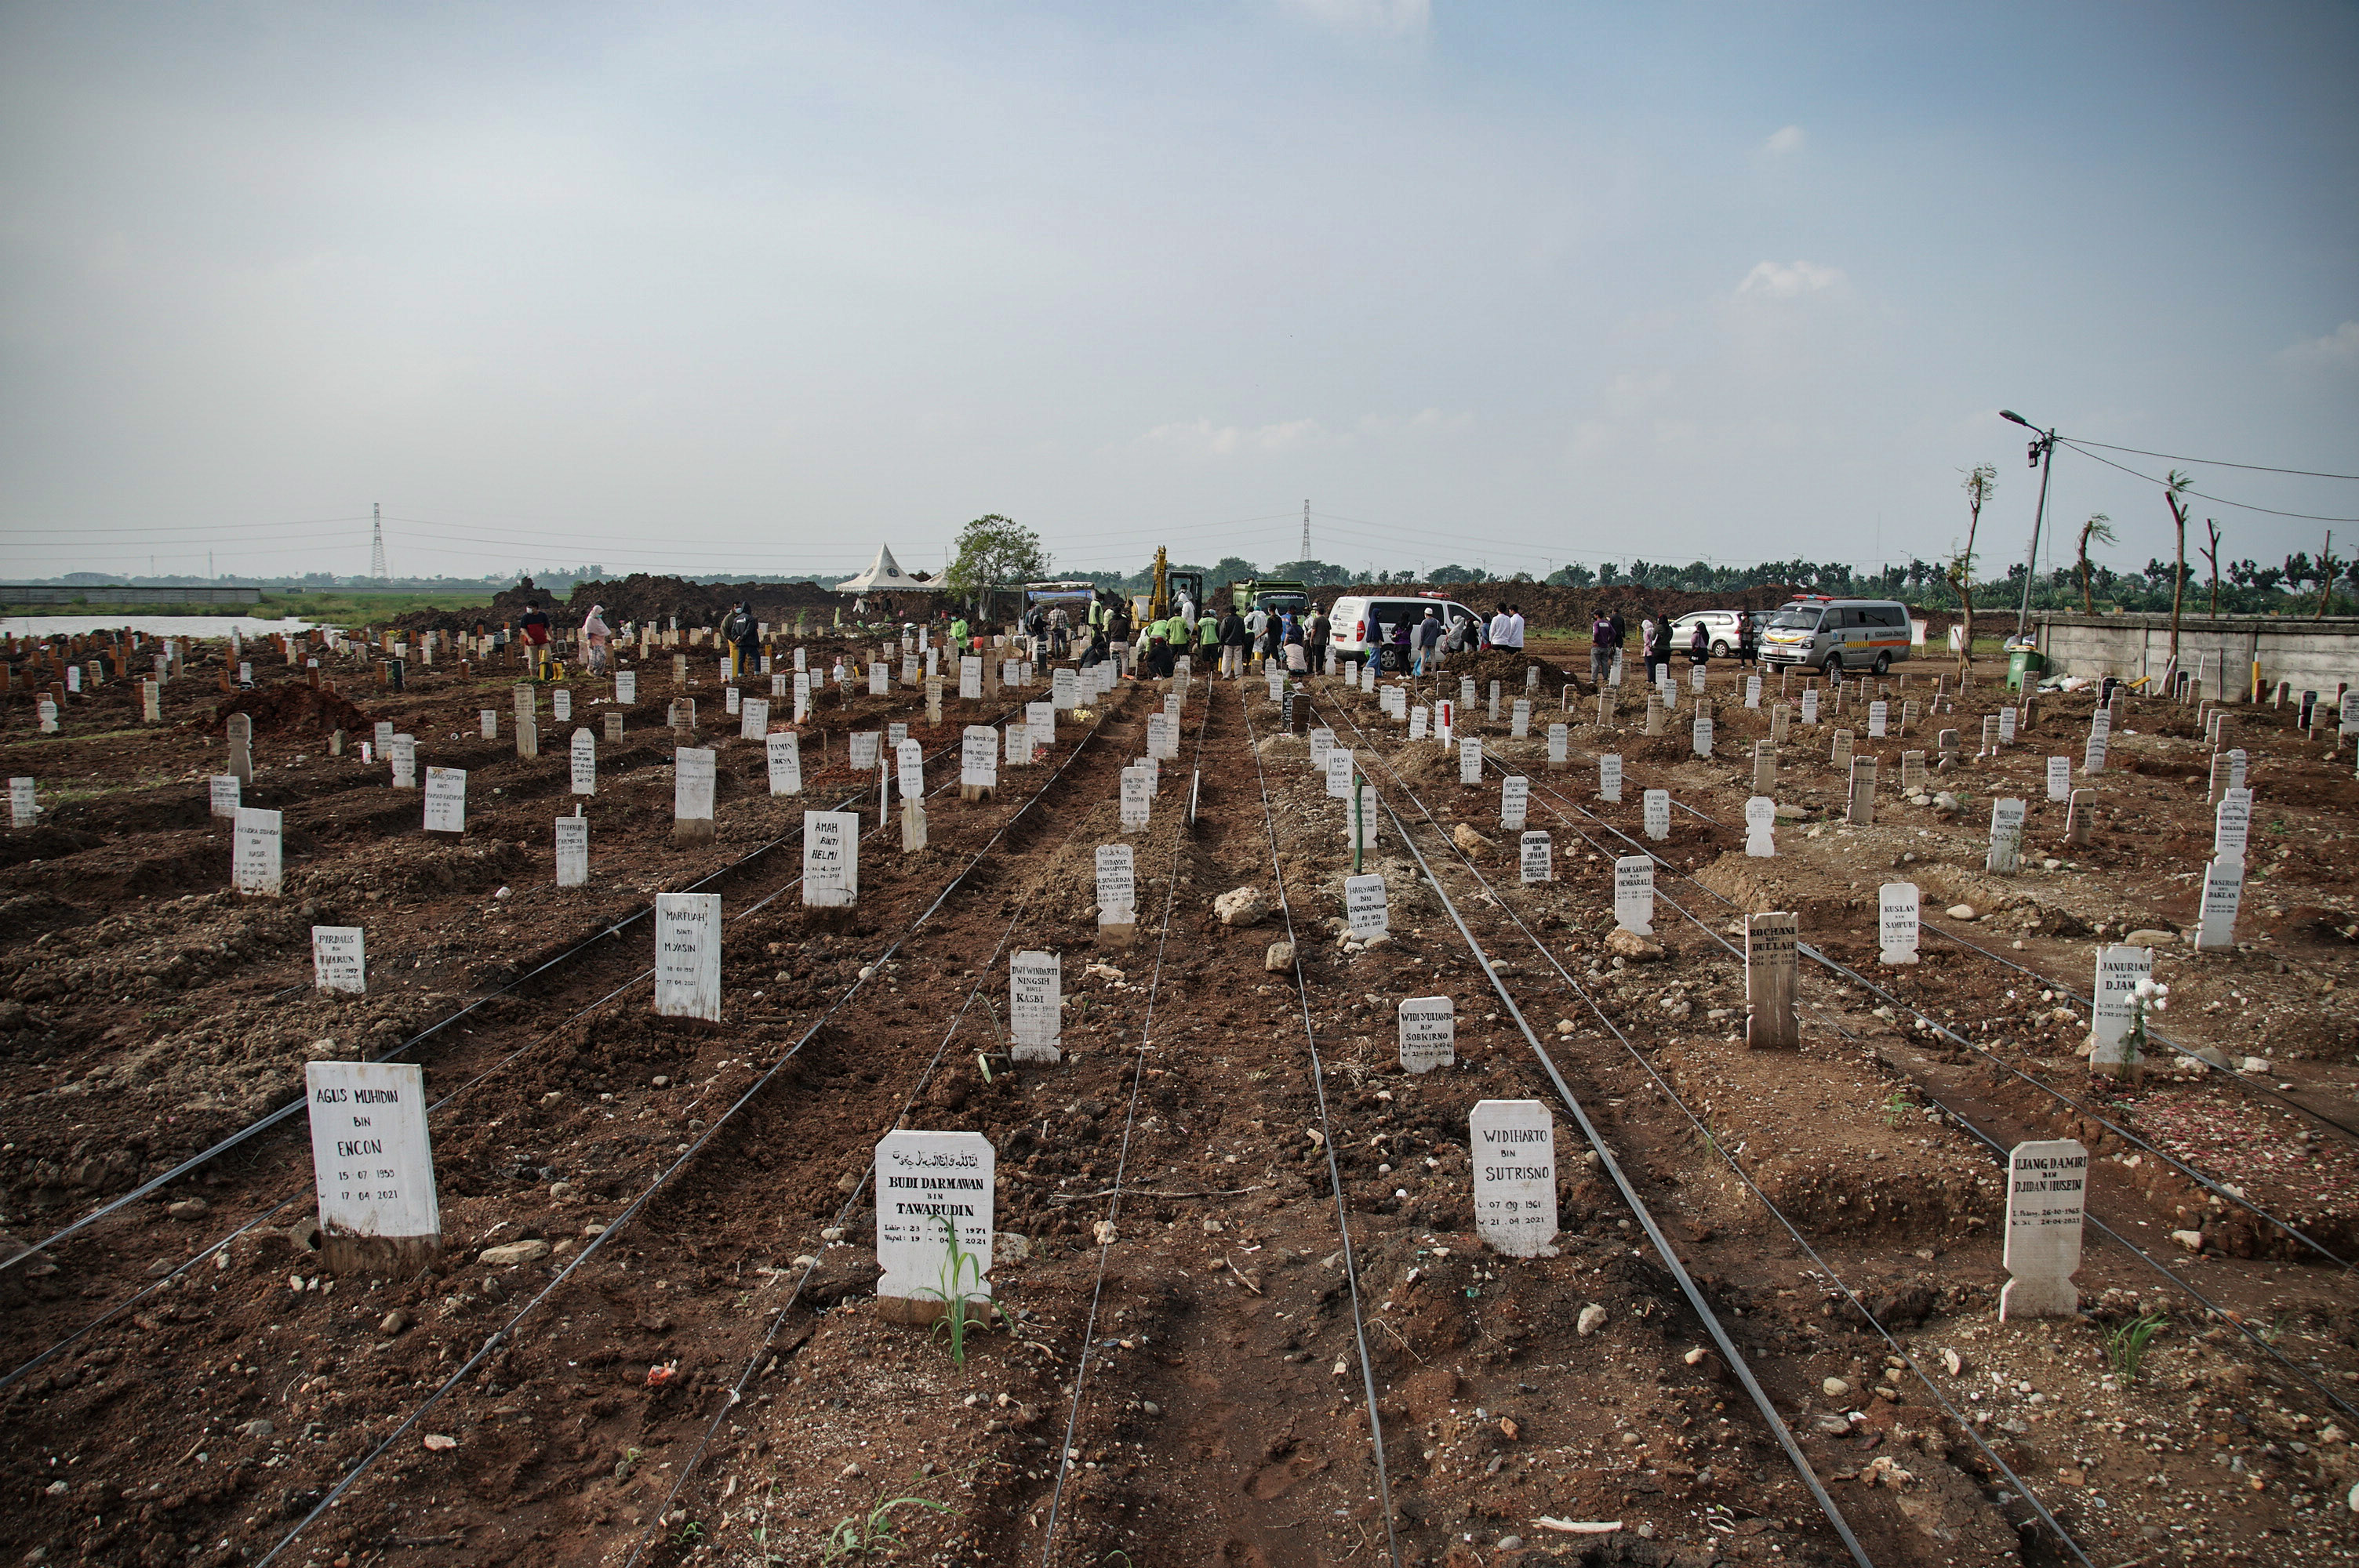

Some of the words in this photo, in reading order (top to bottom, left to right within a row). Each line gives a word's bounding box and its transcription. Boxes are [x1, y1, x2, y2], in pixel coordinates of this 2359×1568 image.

[816, 823, 838, 833] AMAH
[1350, 885, 1382, 894] HARYANTO
[666, 912, 706, 922] MARFUAH
[1750, 927, 1795, 937] ROCHANI
[1753, 942, 1794, 952] DULLAH
[2101, 962, 2150, 972] JANURIAH
[1017, 977, 1049, 985] NINGSIH
[1016, 993, 1044, 1004] KASBI
[1401, 1012, 1419, 1022] WIDI
[1420, 1012, 1453, 1022] YULIANTO
[317, 1088, 347, 1104] AGUS
[355, 1088, 399, 1105] MUHIDIN
[353, 1116, 371, 1128] BIN
[1482, 1129, 1548, 1145] WIDIHARTO
[338, 1138, 383, 1157] ENCON
[1500, 1149, 1516, 1159] BIN
[2014, 1158, 2048, 1171] UJANG
[2049, 1156, 2087, 1169] DAMIRI
[338, 1171, 350, 1181] 15
[358, 1171, 367, 1180] 07
[1485, 1165, 1550, 1184] SUTRISNO
[888, 1176, 918, 1189] BUDI
[921, 1178, 983, 1190] DARMAWAN
[2048, 1179, 2082, 1192] HUSEIN
[341, 1192, 350, 1200] 17
[358, 1191, 370, 1201] 04
[376, 1189, 398, 1200] 2021
[1525, 1200, 1542, 1209] 1961
[896, 1203, 974, 1217] TAWARUDIN
[1525, 1215, 1545, 1224] 2021
